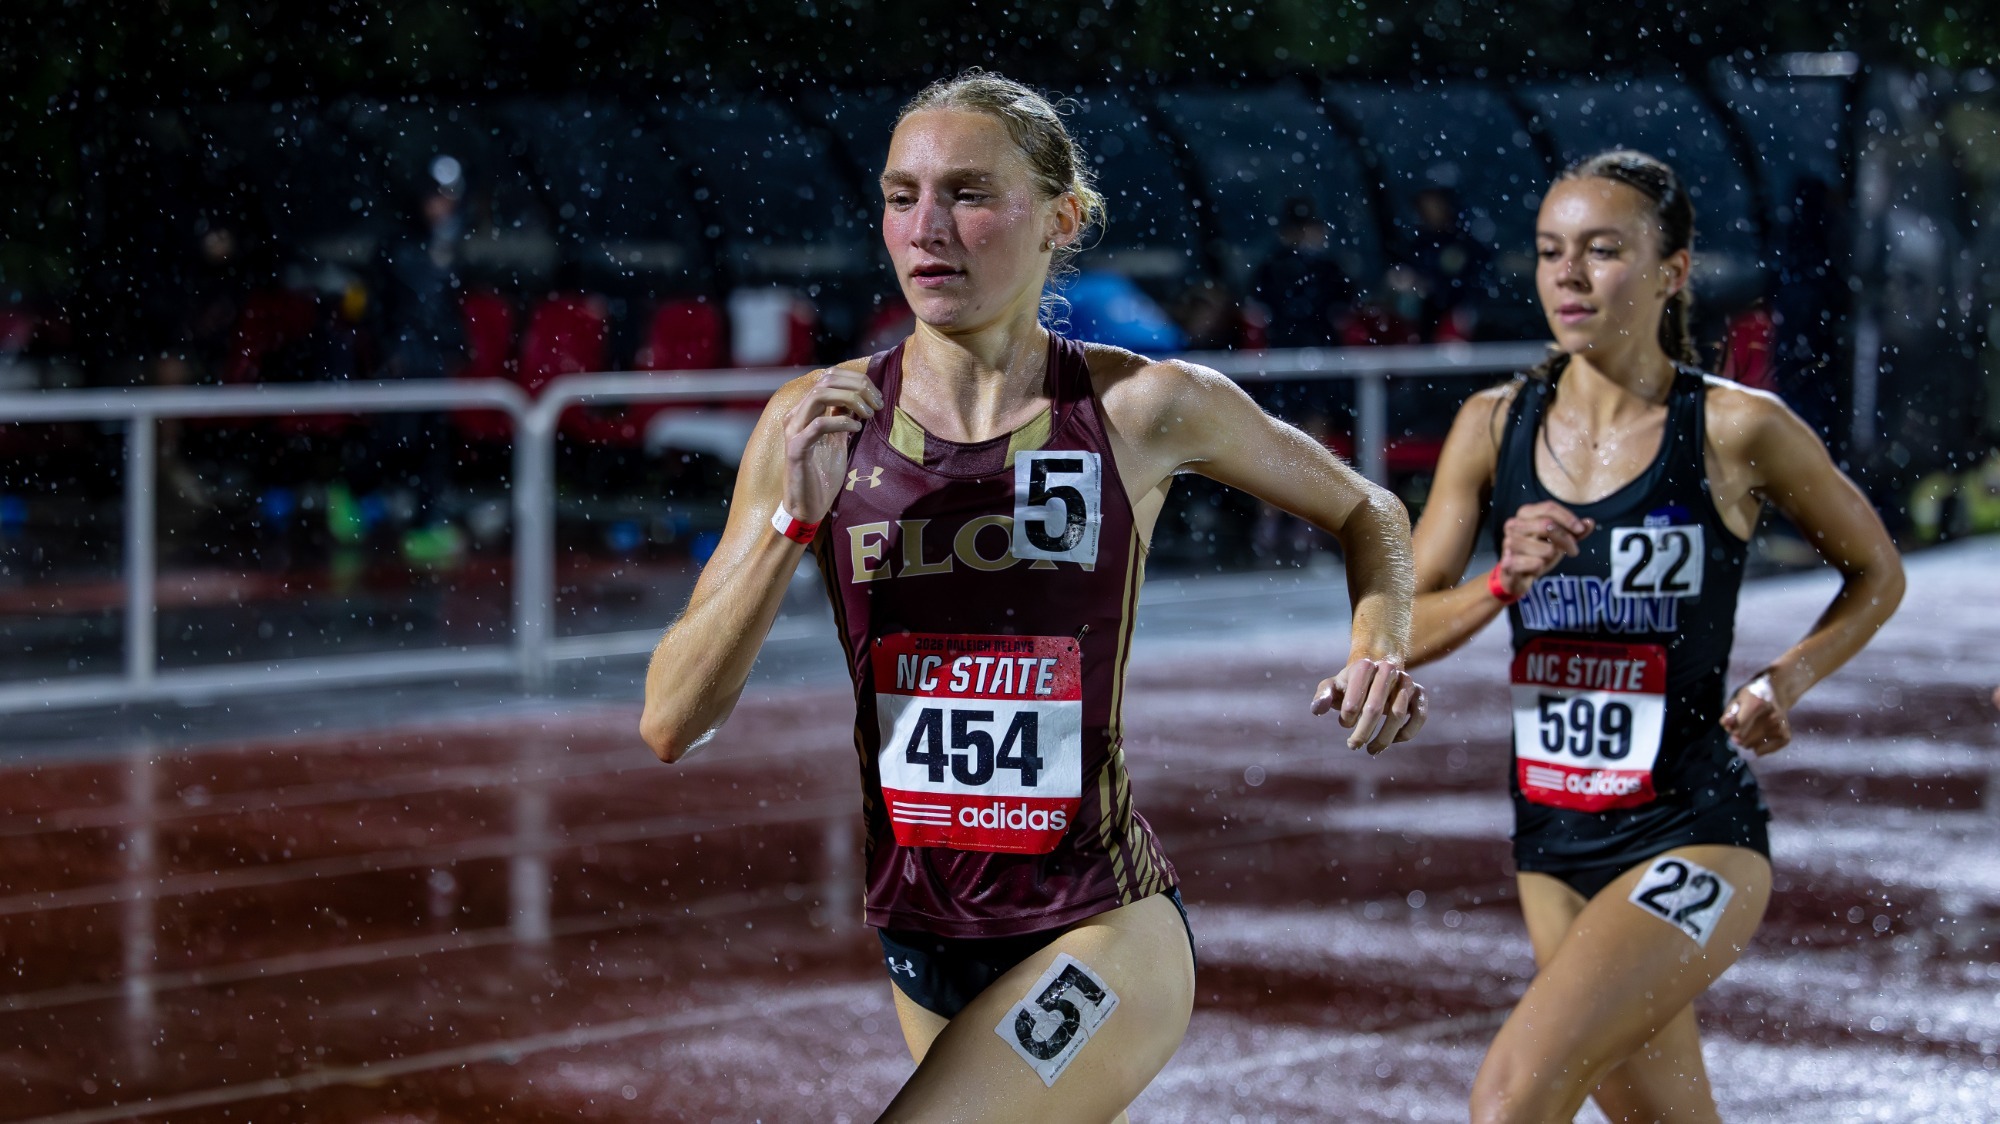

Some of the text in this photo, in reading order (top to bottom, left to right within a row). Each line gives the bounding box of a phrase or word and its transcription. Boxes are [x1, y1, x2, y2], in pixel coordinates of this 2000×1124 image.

[1024, 458, 1087, 553] 5
[846, 514, 1103, 584] ELO
[1618, 530, 1691, 593] 22
[896, 653, 1059, 696] NC STATE
[1526, 652, 1648, 691] NC STATE
[905, 707, 1044, 788] 454
[1538, 694, 1633, 761] 599
[957, 801, 1068, 831] adidas
[1565, 769, 1642, 797] adidas
[1637, 860, 1722, 937] 22
[1014, 963, 1107, 1061] 5
